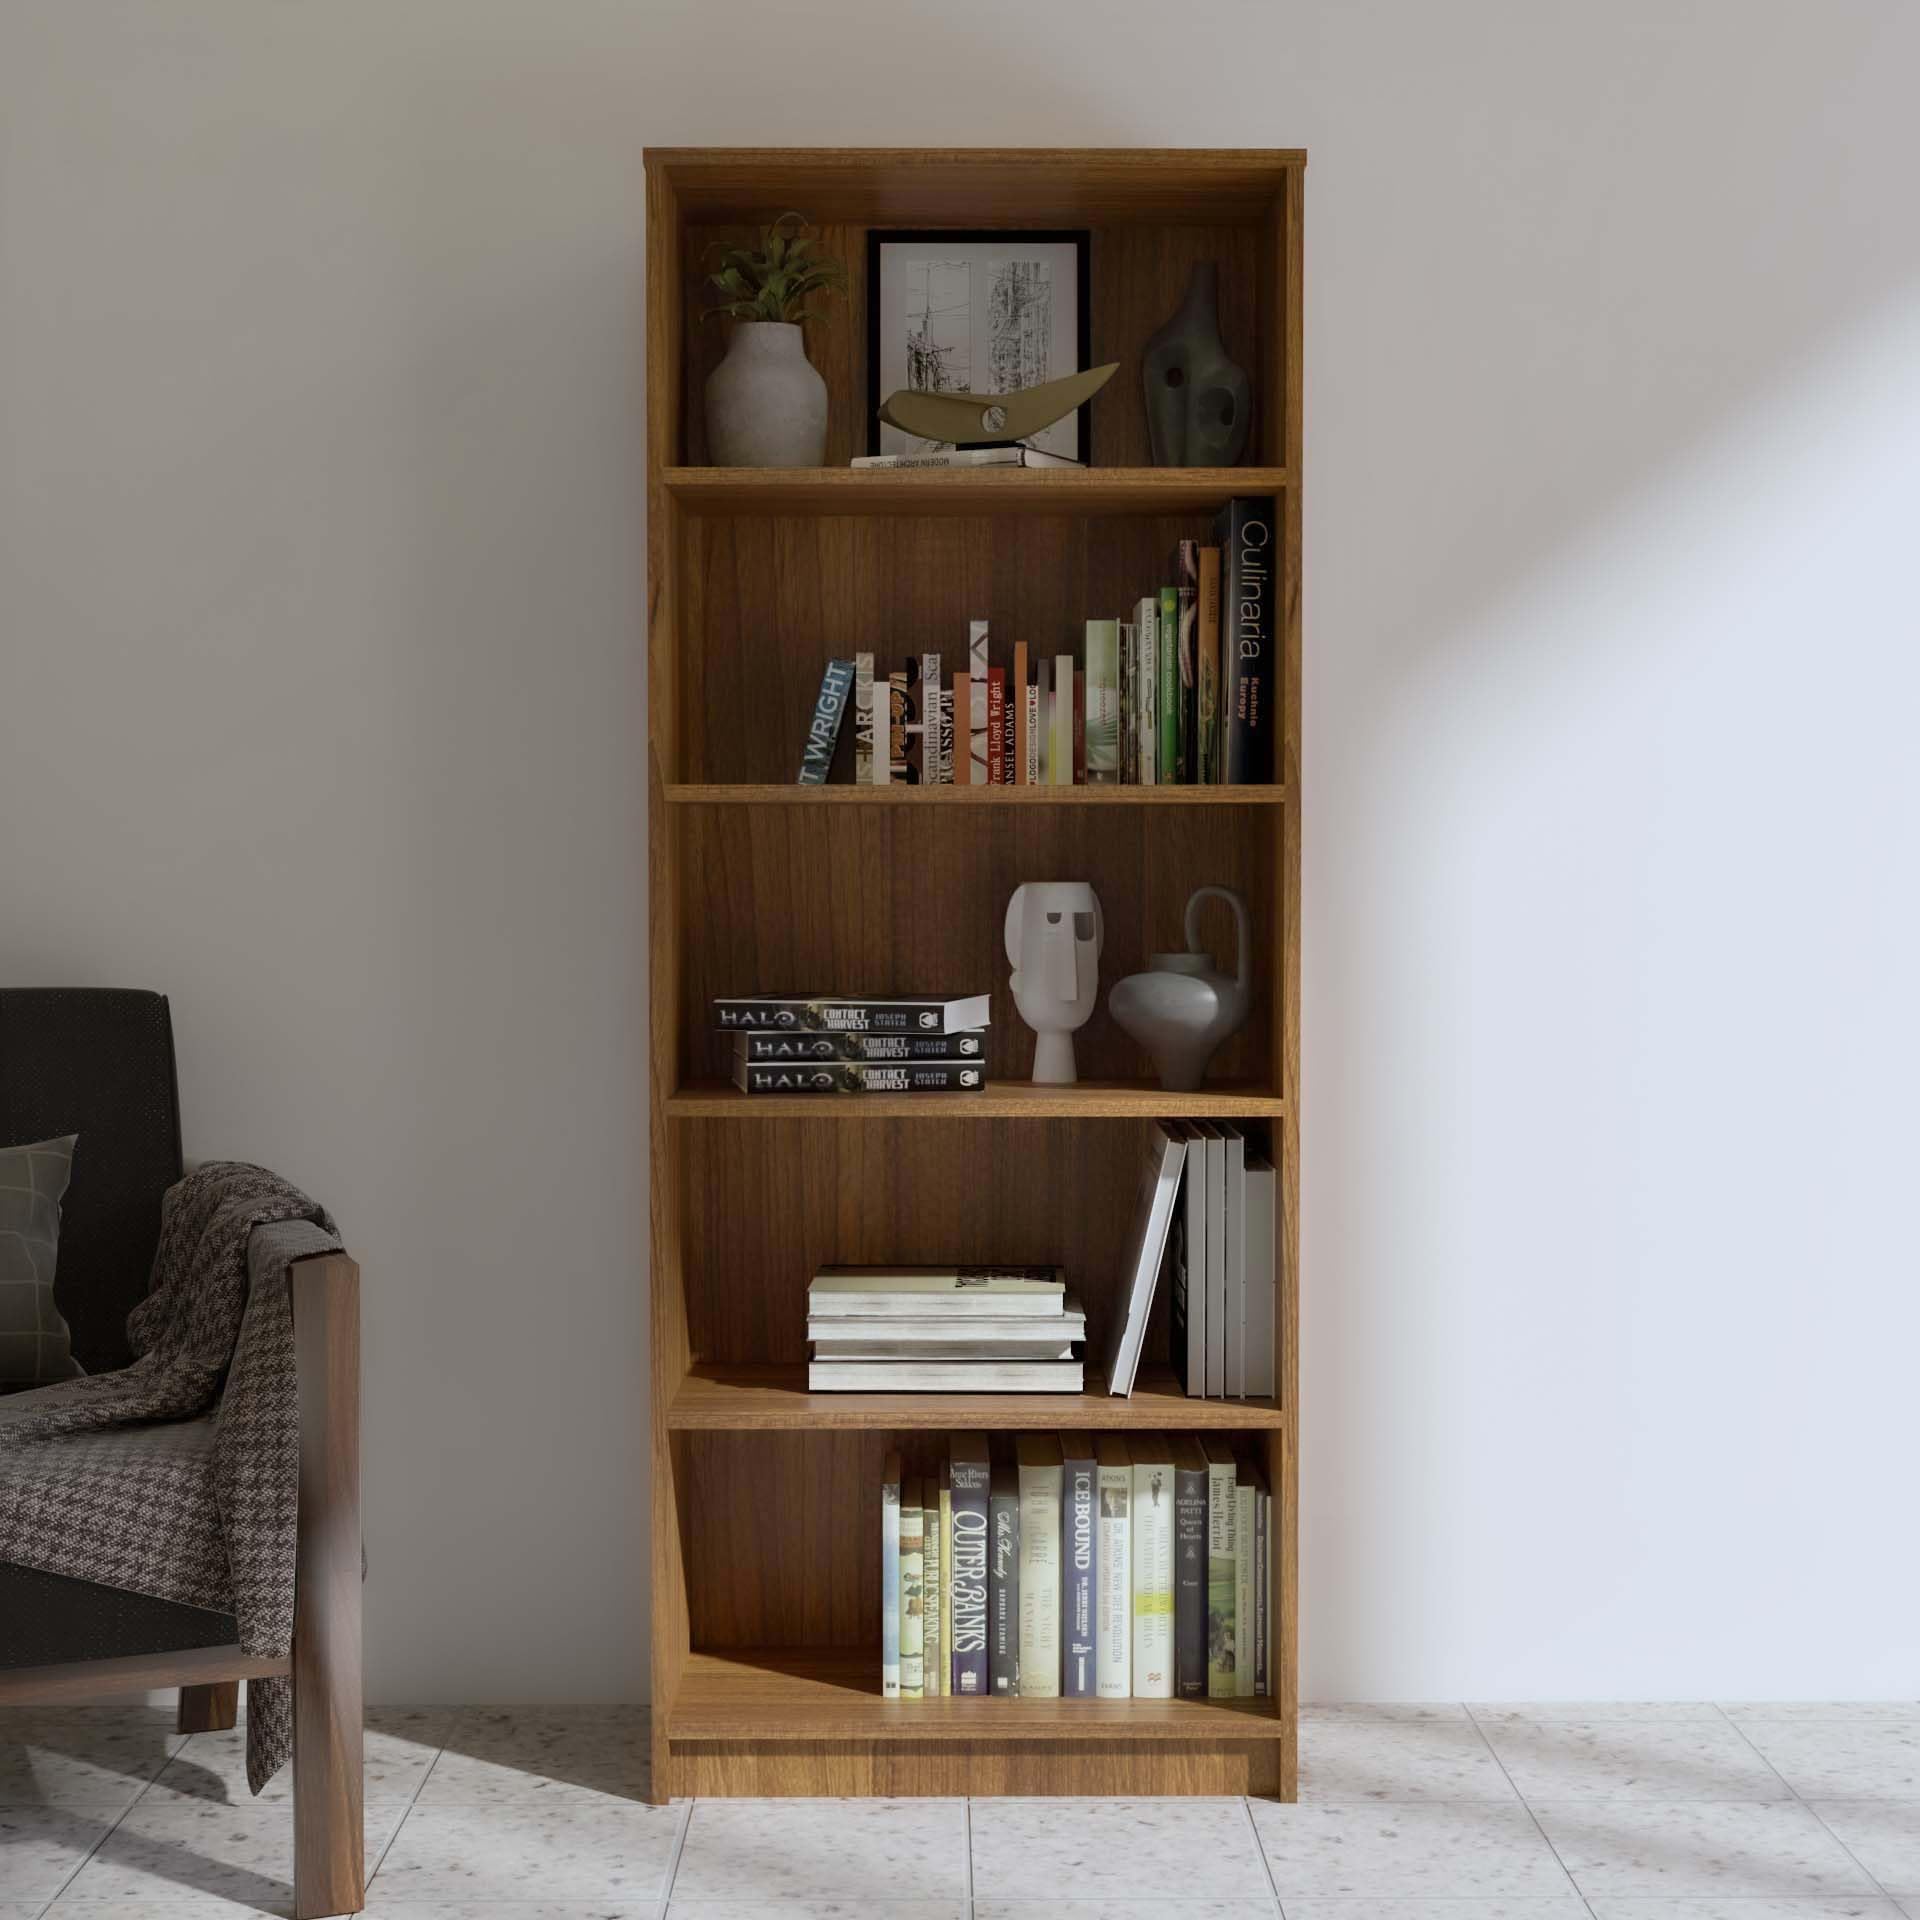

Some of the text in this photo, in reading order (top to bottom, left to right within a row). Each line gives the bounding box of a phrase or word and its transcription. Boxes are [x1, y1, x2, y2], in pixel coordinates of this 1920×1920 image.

[921, 457, 949, 466] MODERN
[1239, 520, 1268, 660] Culinaria
[804, 662, 846, 760] WRIGHT
[1166, 672, 1175, 715] cookbook
[1237, 677, 1248, 720] Europy
[1249, 677, 1260, 728] Kuchnie
[924, 654, 938, 784] Scandinavian Sca
[990, 680, 1002, 785] Frank Lloyd Wright
[1005, 703, 1015, 785] ANSEL ADAMS
[720, 1010, 796, 1025] HALO
[823, 1009, 867, 1019] CONTACT
[826, 1019, 870, 1030] HARVEST
[755, 1041, 834, 1057] HALO
[862, 1038, 907, 1048] CONTACT
[864, 1048, 910, 1058] HARVEST
[755, 1073, 833, 1088] HALO
[862, 1069, 907, 1080] CONTACT
[865, 1079, 910, 1090] HARVEST
[1031, 1486, 1048, 1514] JOHN
[1074, 1471, 1091, 1569] ICE BOUND
[1211, 1477, 1224, 1551] James Herriot
[953, 1511, 987, 1580] OUTER
[993, 1539, 1012, 1579] Kennedy
[924, 1559, 939, 1594] PUBLIC
[1143, 1536, 1154, 1614] MATHEMATICAL
[924, 1594, 939, 1644] SPEAKING
[950, 1581, 987, 1653] BANKS
[998, 1589, 1006, 1621] BARBARA
[1023, 1592, 1035, 1648] MANAGER
